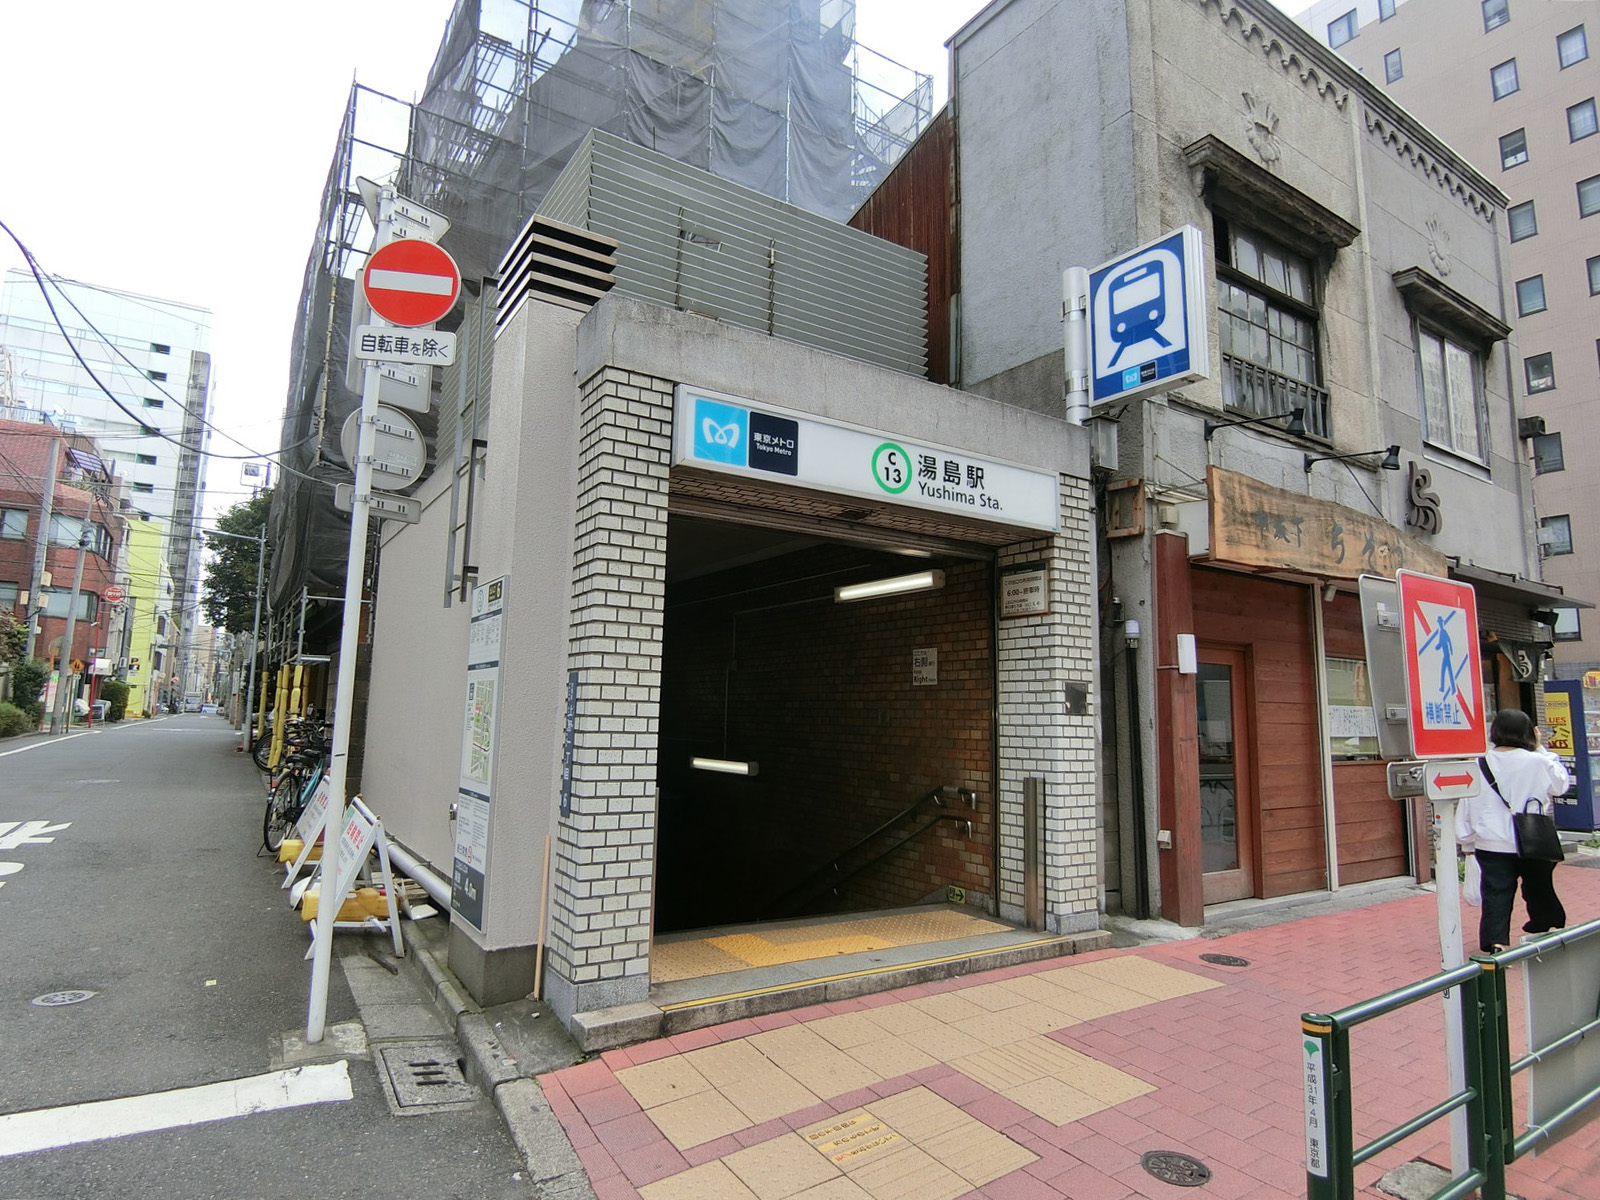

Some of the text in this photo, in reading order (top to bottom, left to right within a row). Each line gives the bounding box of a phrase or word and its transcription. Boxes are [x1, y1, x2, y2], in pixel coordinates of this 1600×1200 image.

[361, 333, 449, 358] 自転車を除く
[753, 432, 795, 449] 東京メトロ
[756, 443, 792, 456] Tokyo Metro
[888, 451, 897, 466] C
[884, 467, 902, 484] 13
[917, 453, 985, 490] 湯島駅
[918, 481, 1003, 510] Yushima Sta.
[913, 675, 928, 684] Right
[1425, 701, 1462, 725] 横断禁止
[1306, 1062, 1321, 1169] 平成31年4月 東京都
